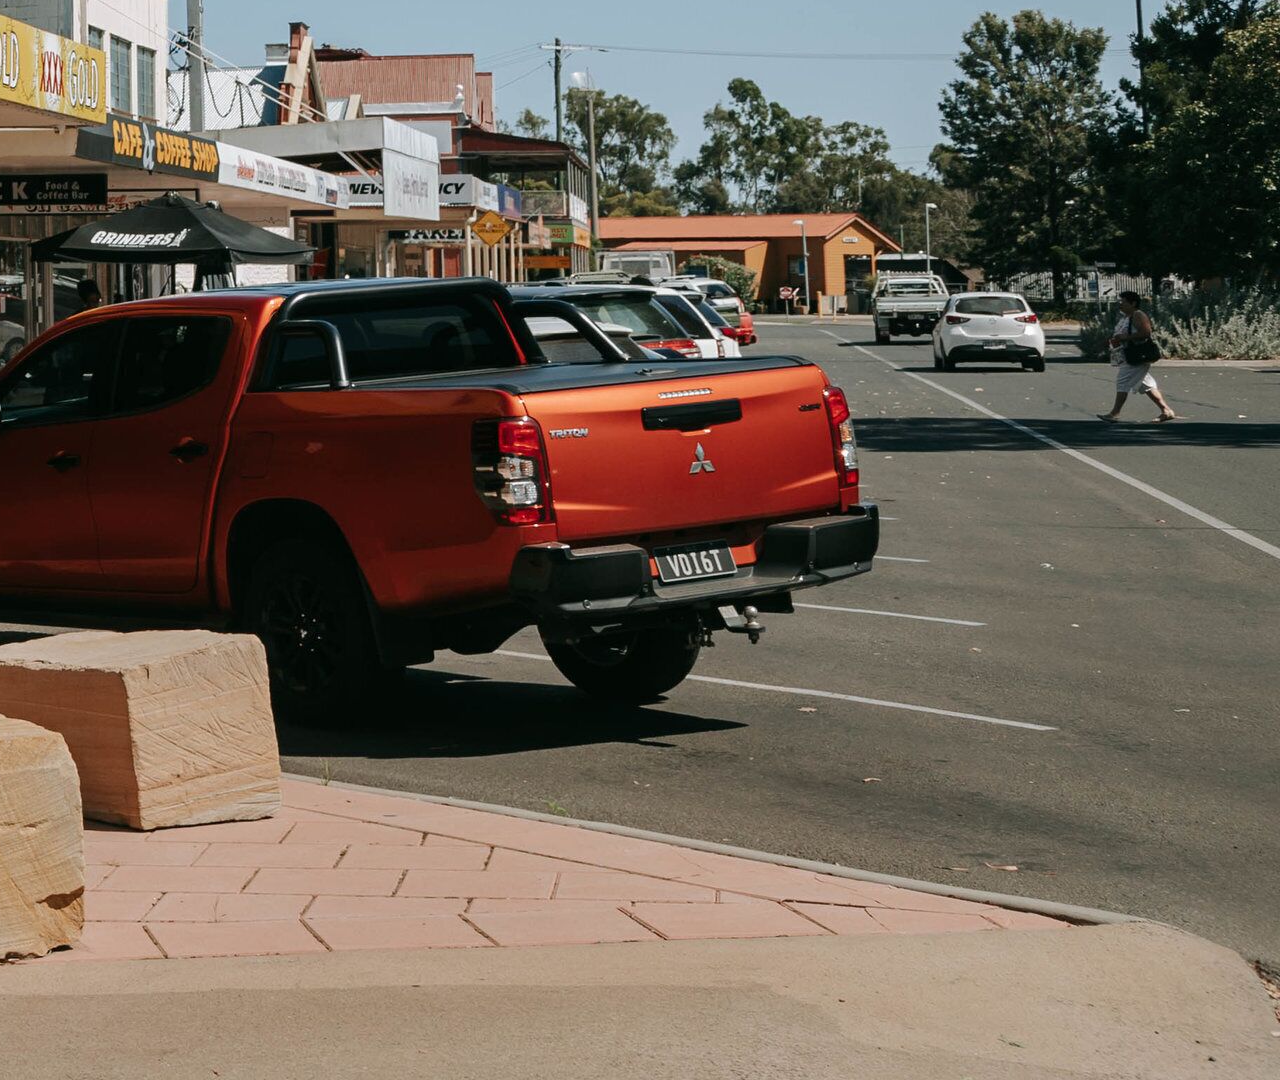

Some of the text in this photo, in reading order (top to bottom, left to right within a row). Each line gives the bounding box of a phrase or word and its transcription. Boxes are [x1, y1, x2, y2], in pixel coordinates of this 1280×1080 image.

[40, 50, 99, 109] XXXX GOLD
[113, 120, 143, 158] CAFE
[142, 122, 155, 170] &
[155, 131, 192, 169] COFFEE
[192, 139, 219, 173] SHOP
[45, 181, 80, 191] Food &
[36, 191, 89, 200] Coffee Bar
[90, 230, 175, 246] GRINDERS
